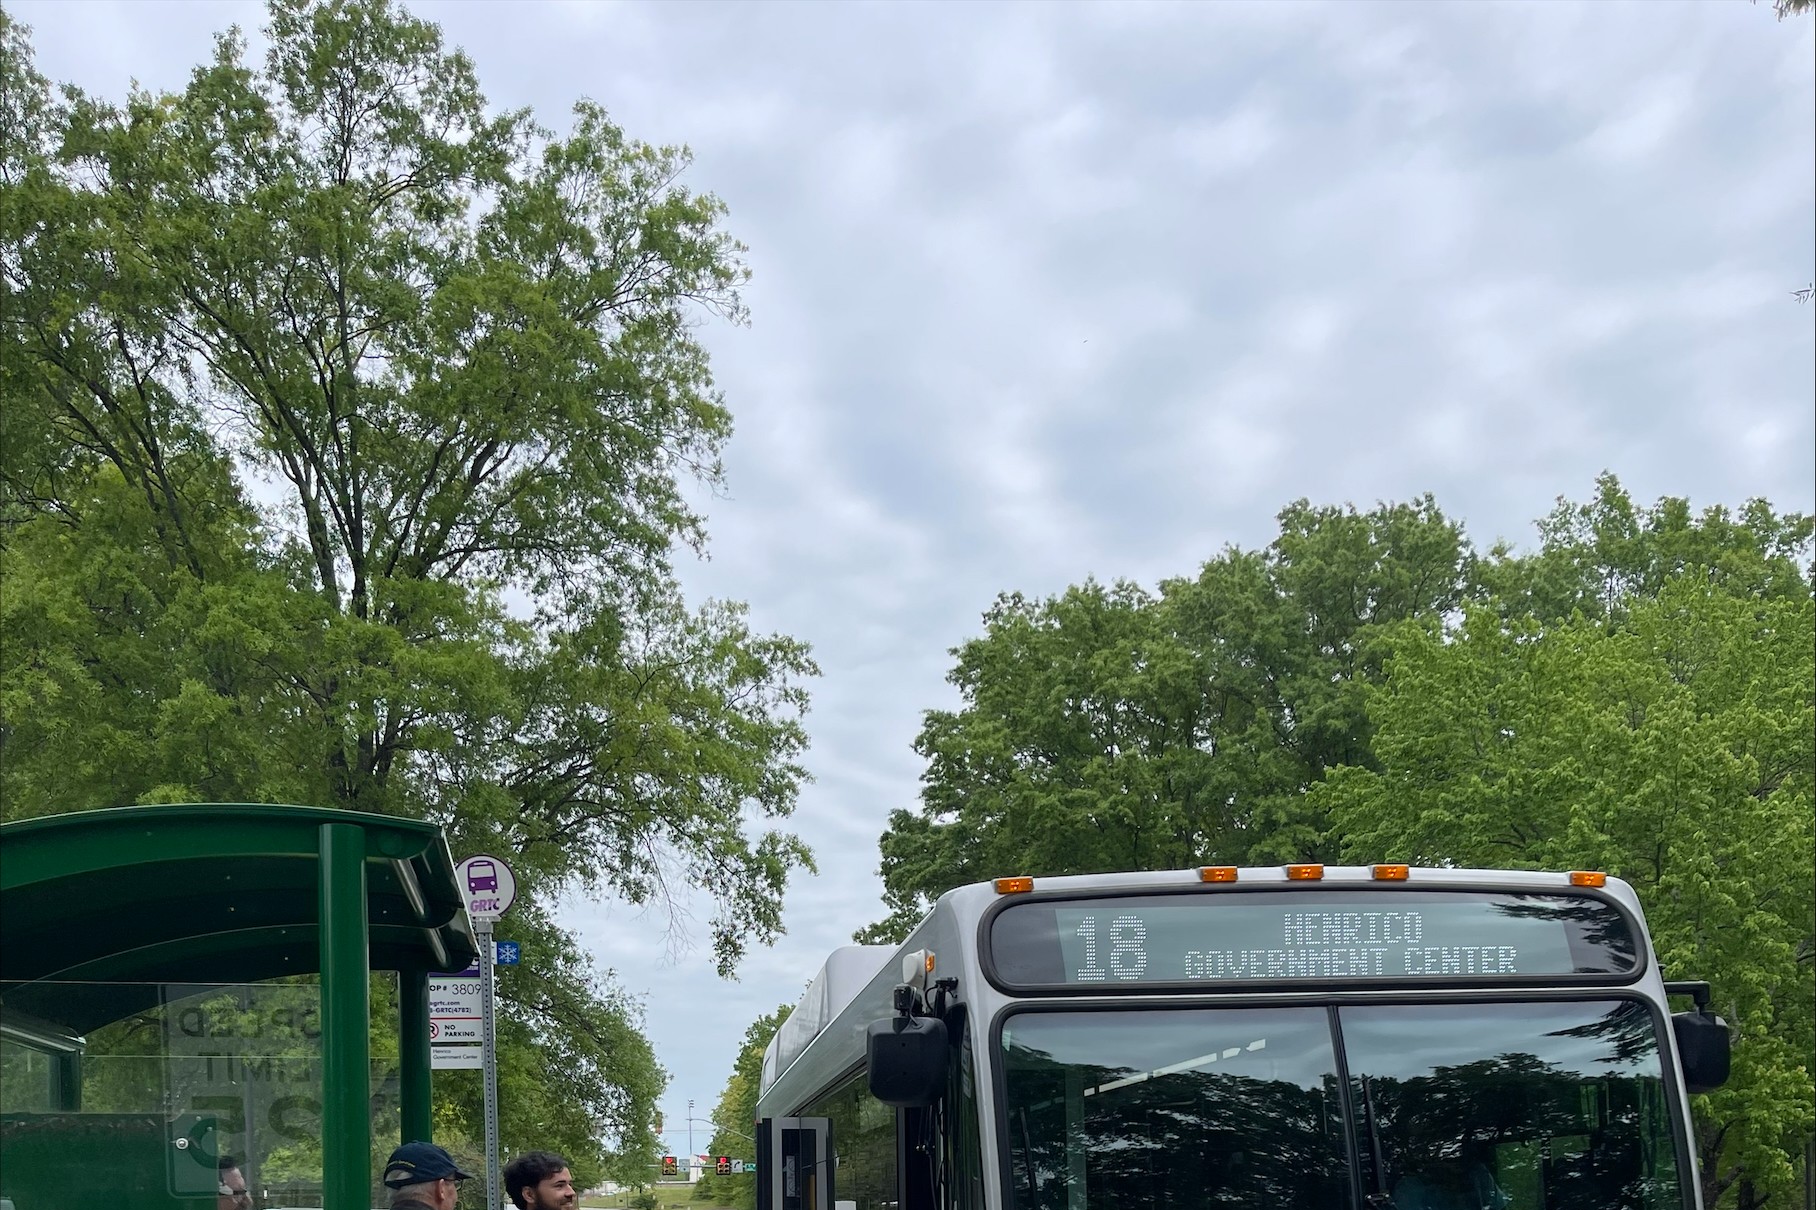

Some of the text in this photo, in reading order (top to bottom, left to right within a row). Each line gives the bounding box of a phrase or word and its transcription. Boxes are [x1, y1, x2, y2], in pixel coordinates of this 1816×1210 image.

[470, 898, 500, 913] GRTC
[1284, 912, 1423, 945] HENRICO
[1076, 915, 1147, 981] 18
[1184, 946, 1517, 979] GOVERNMENT CENTER
[429, 984, 442, 992] OP
[451, 983, 481, 996] 3809
